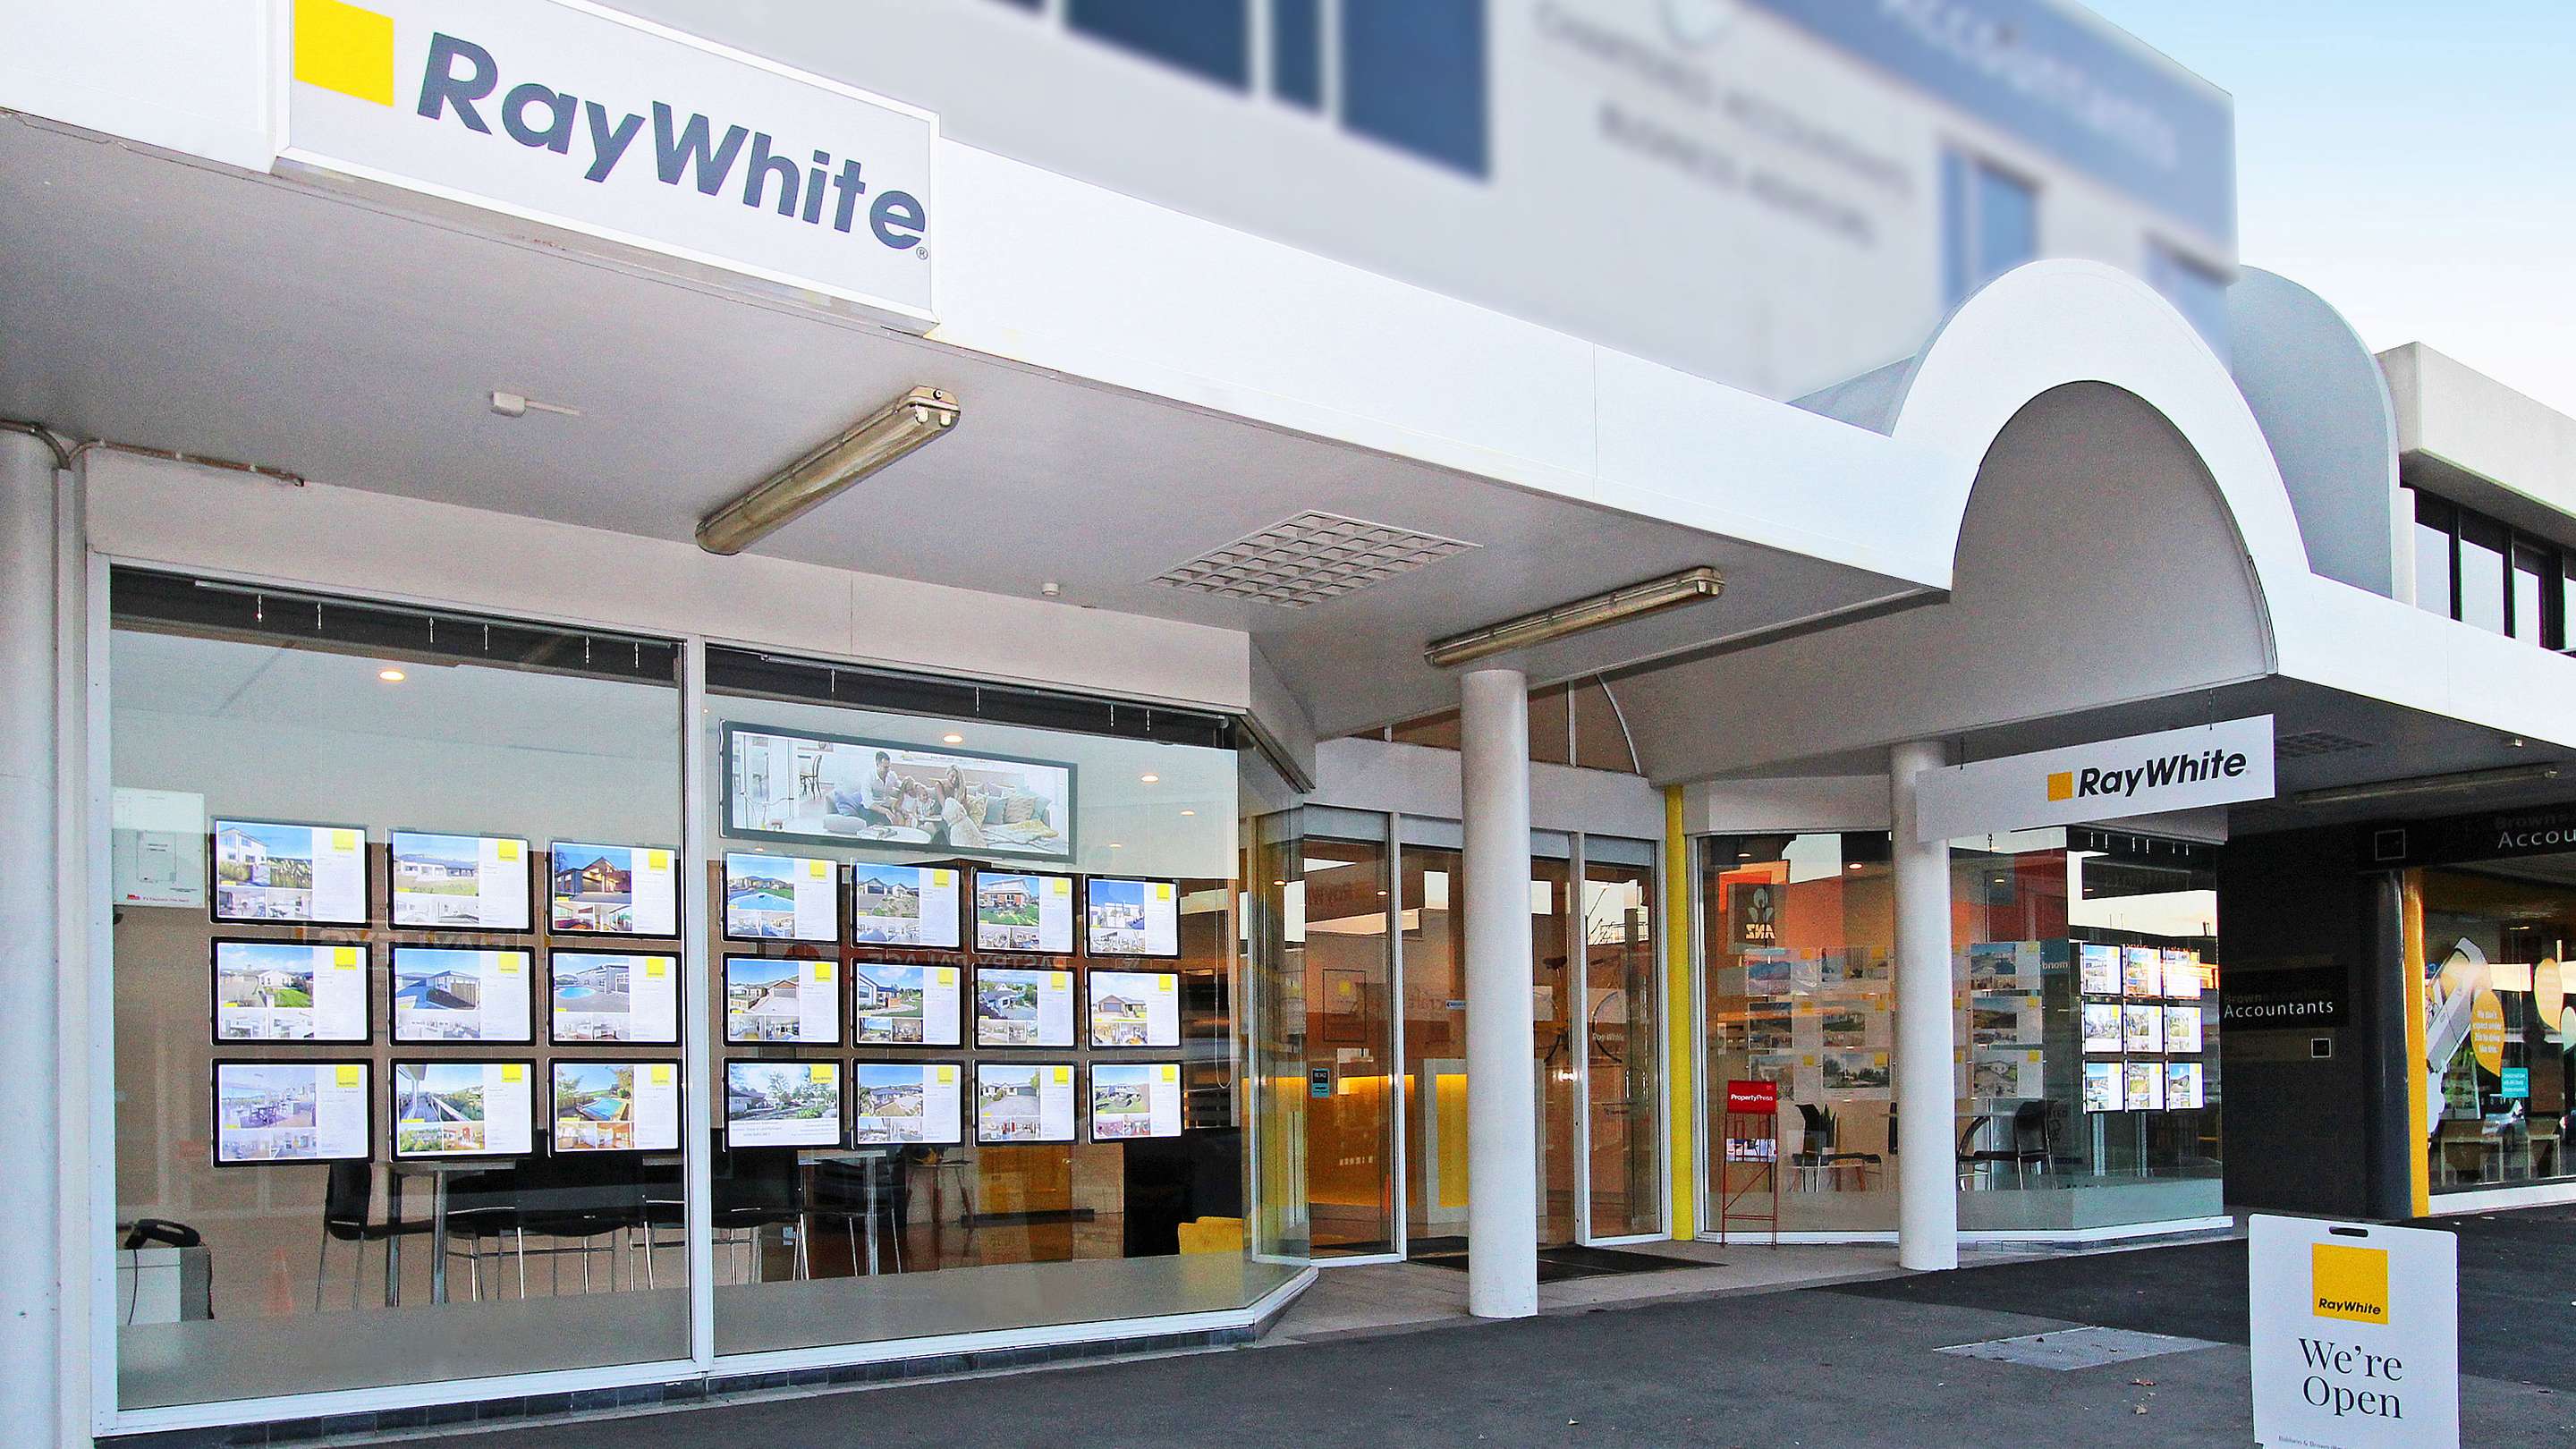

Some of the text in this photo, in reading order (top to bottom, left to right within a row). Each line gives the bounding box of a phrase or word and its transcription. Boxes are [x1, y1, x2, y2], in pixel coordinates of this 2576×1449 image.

[2078, 748, 2247, 798] RayWhite
[2224, 1000, 2334, 1019] Accountants
[2318, 1298, 2381, 1315] RayWhite
[2298, 1338, 2403, 1381] We're
[2302, 1376, 2403, 1419] Open
